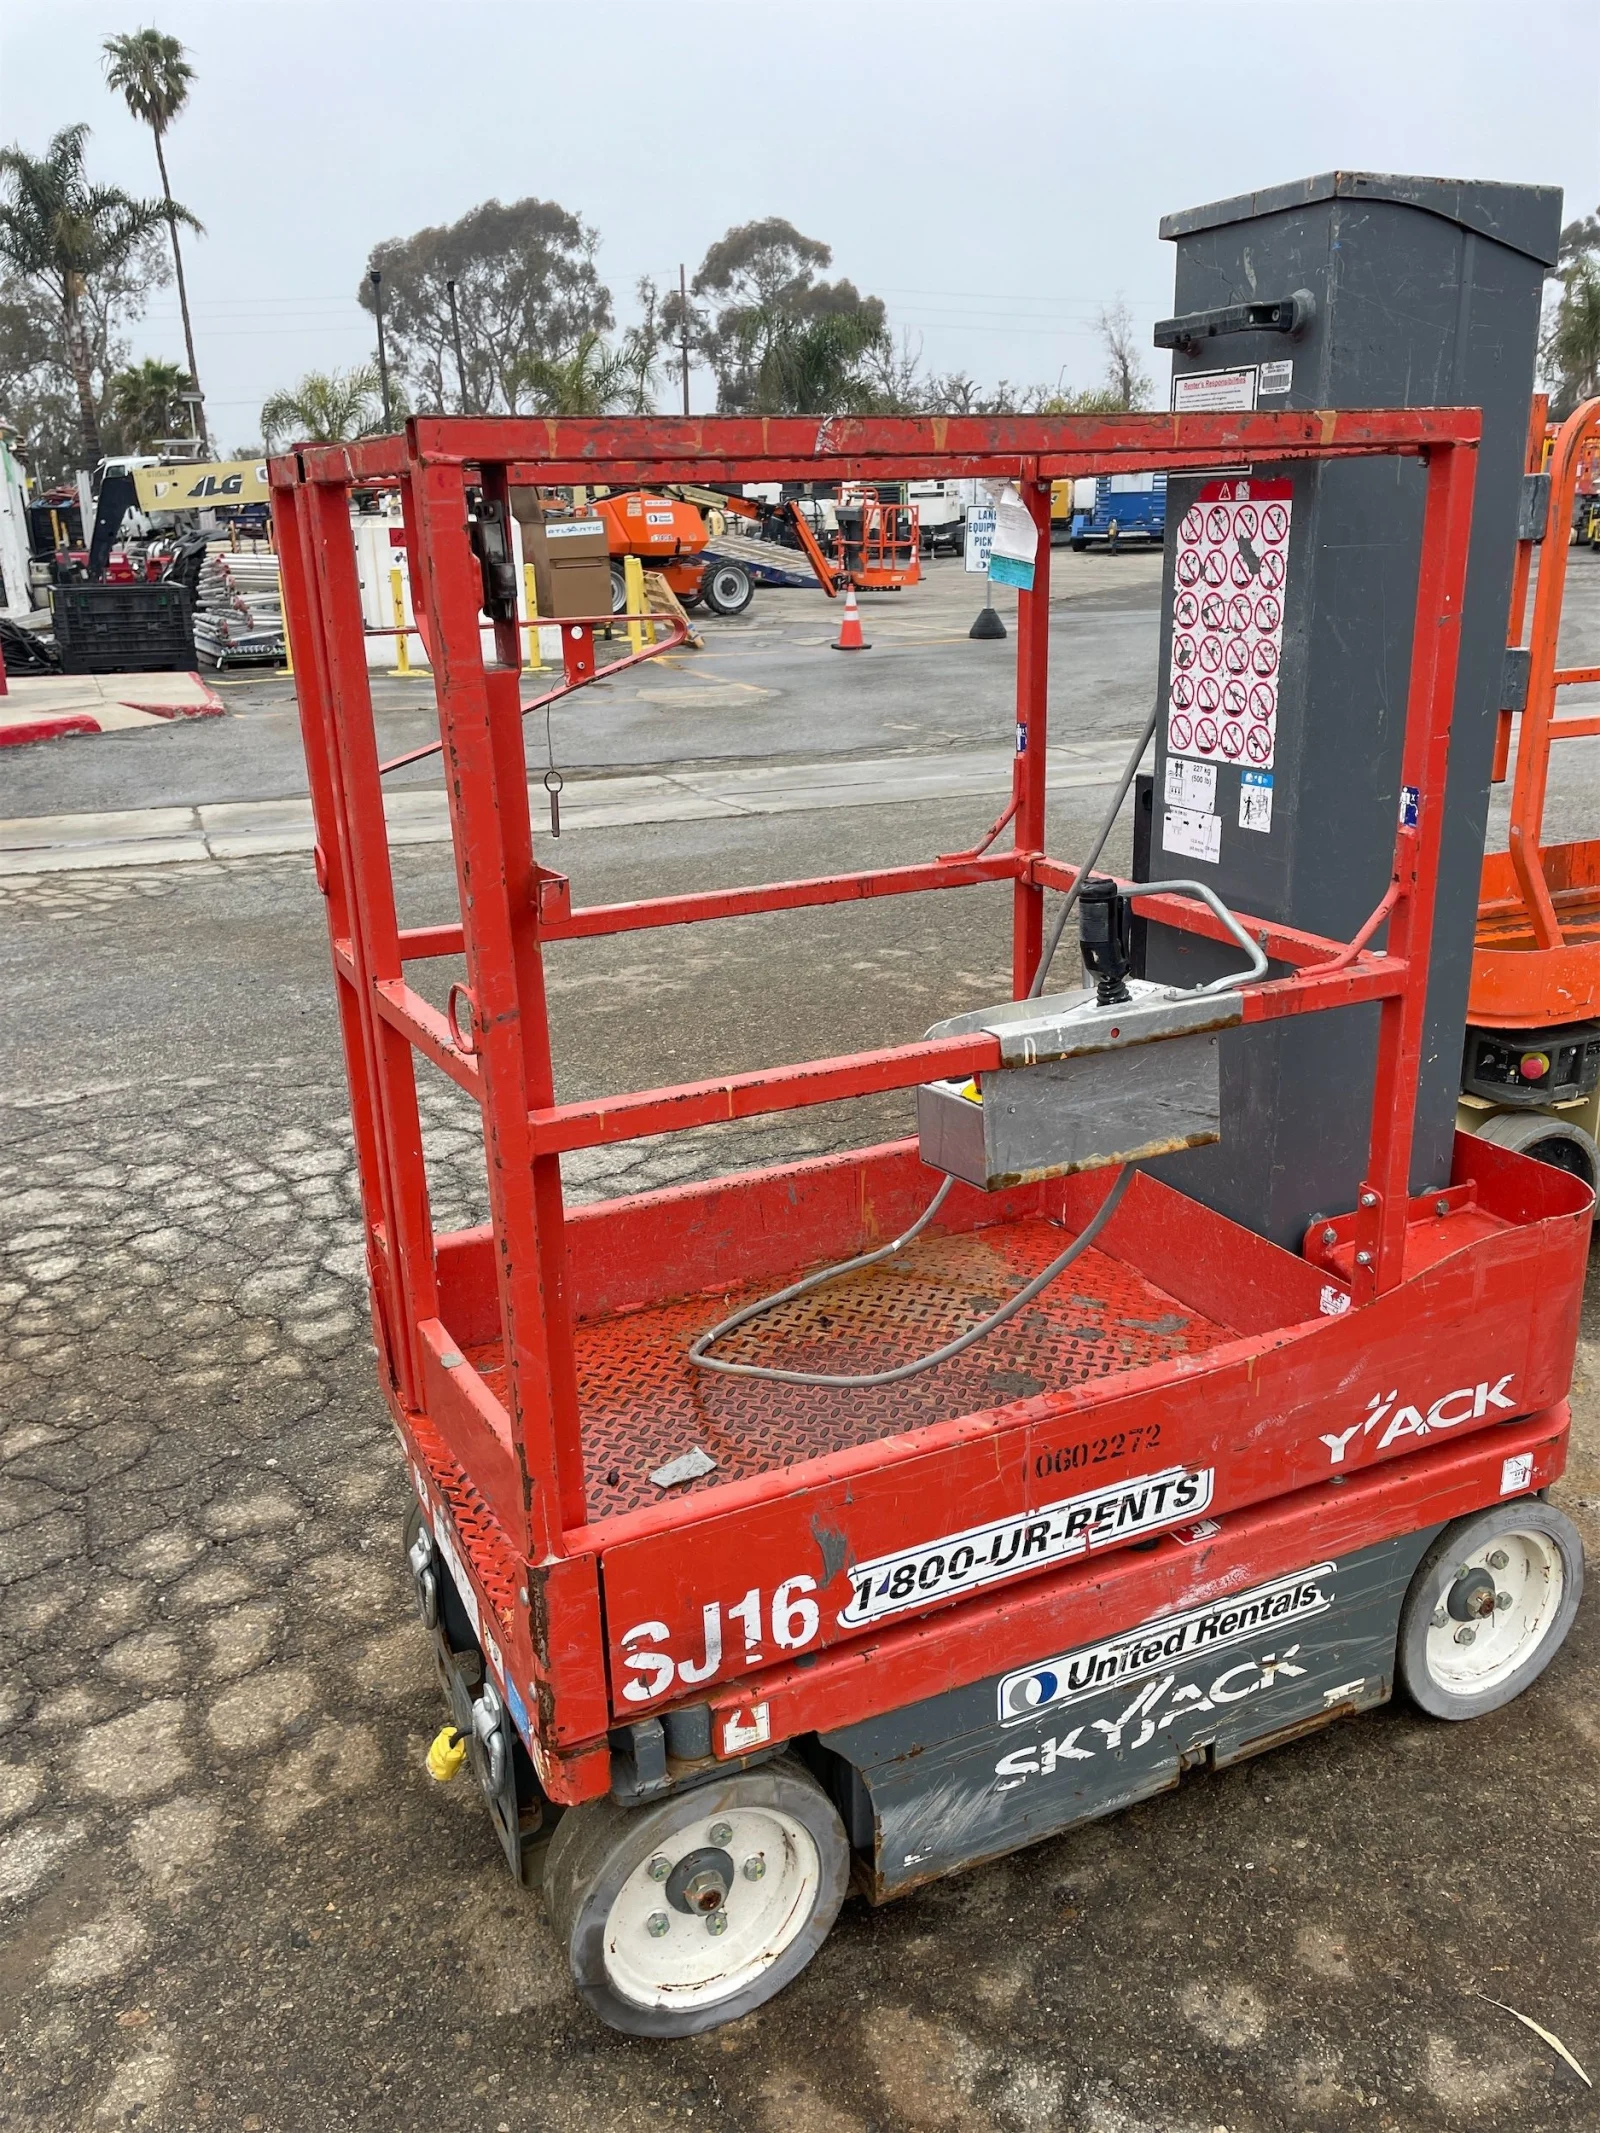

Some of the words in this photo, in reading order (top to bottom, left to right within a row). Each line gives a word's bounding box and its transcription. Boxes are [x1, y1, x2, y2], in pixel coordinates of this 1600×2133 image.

[187, 473, 243, 498] JLG
[974, 536, 993, 547] PICK
[1193, 764, 1204, 773] 227
[1035, 1423, 1161, 1479] 0602272
[620, 1574, 820, 1702] SJ16
[1068, 1626, 1187, 1691] United
[1193, 1583, 1318, 1644] Rentals
